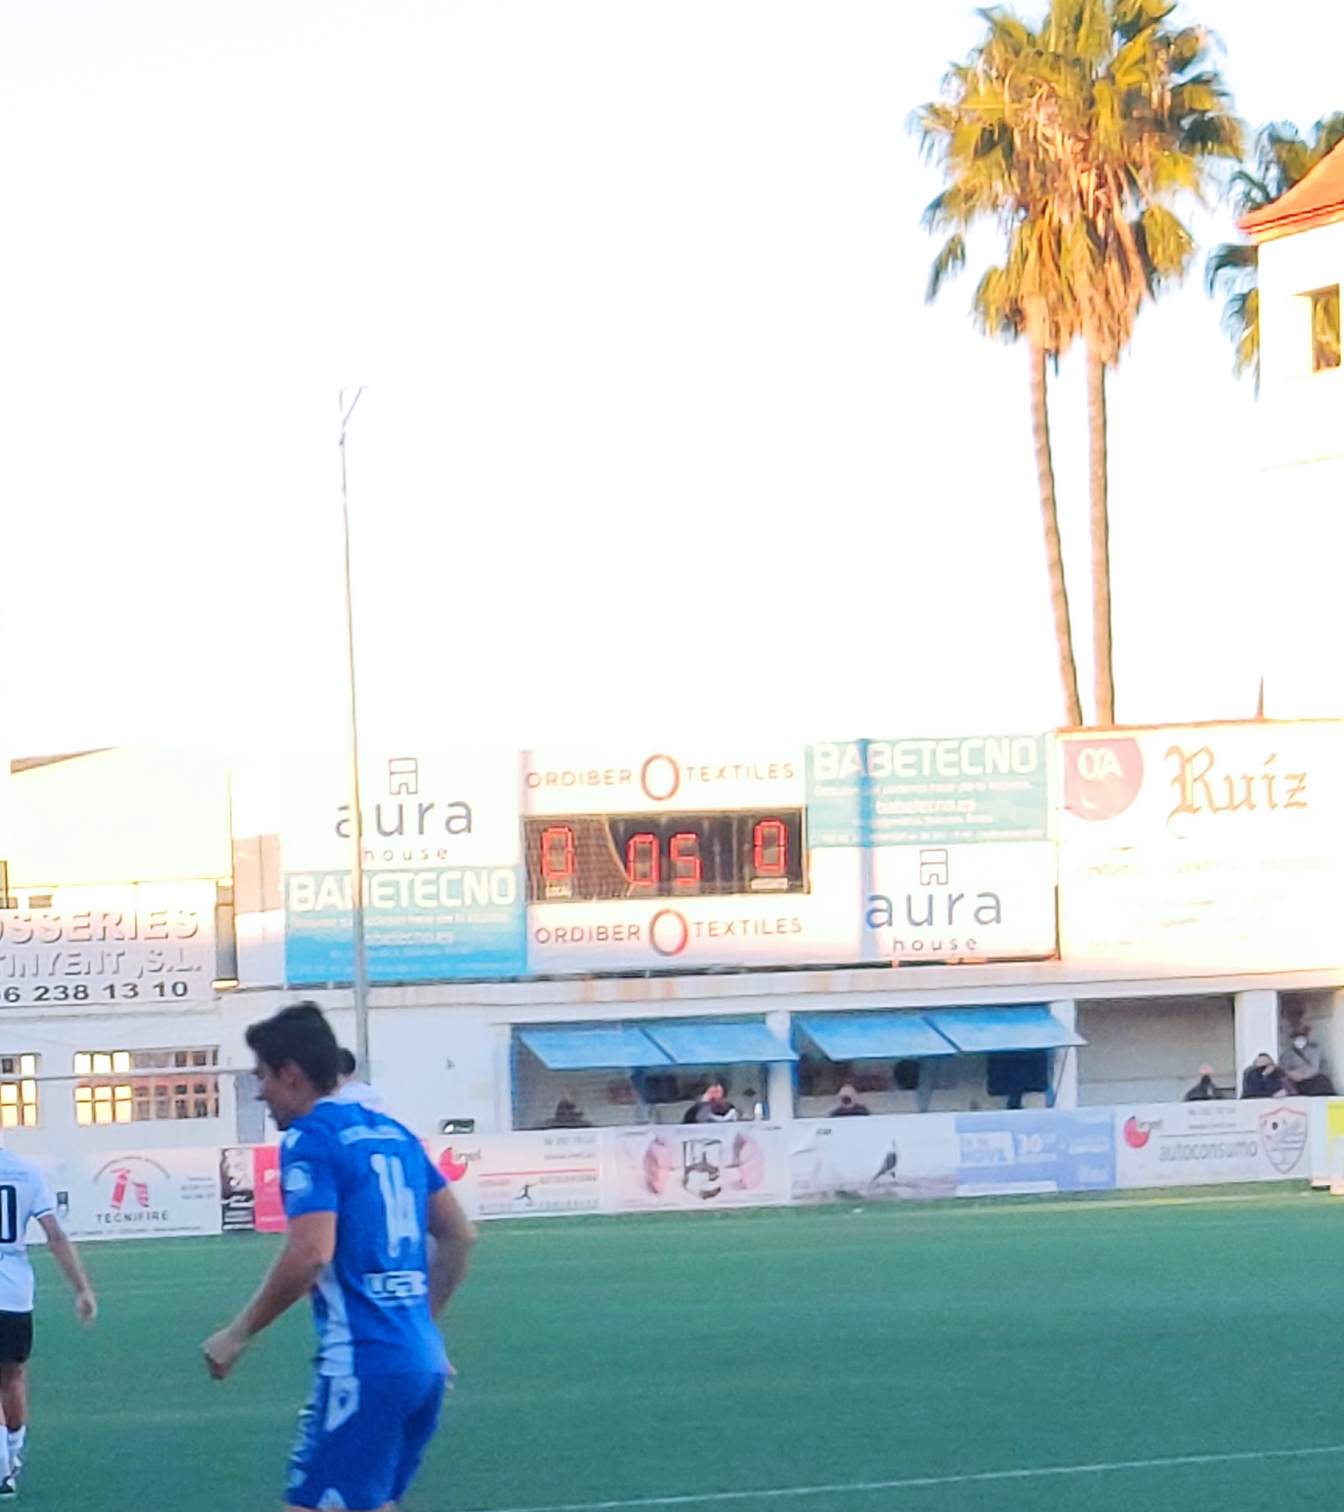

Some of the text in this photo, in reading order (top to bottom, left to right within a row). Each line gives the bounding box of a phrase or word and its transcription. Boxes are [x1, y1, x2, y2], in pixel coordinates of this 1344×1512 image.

[813, 738, 1037, 779] BABETECNO
[525, 770, 633, 789] ORDIBER
[686, 763, 795, 780] TEXTILES
[866, 892, 1001, 928] aura
[535, 925, 641, 944] ORDIBER
[693, 918, 802, 937] TEXTILES
[893, 937, 977, 952] house
[33, 984, 89, 1001] 238
[103, 983, 138, 1000] 13
[153, 981, 188, 998] 10
[95, 1210, 169, 1225] TECNIFIRE
